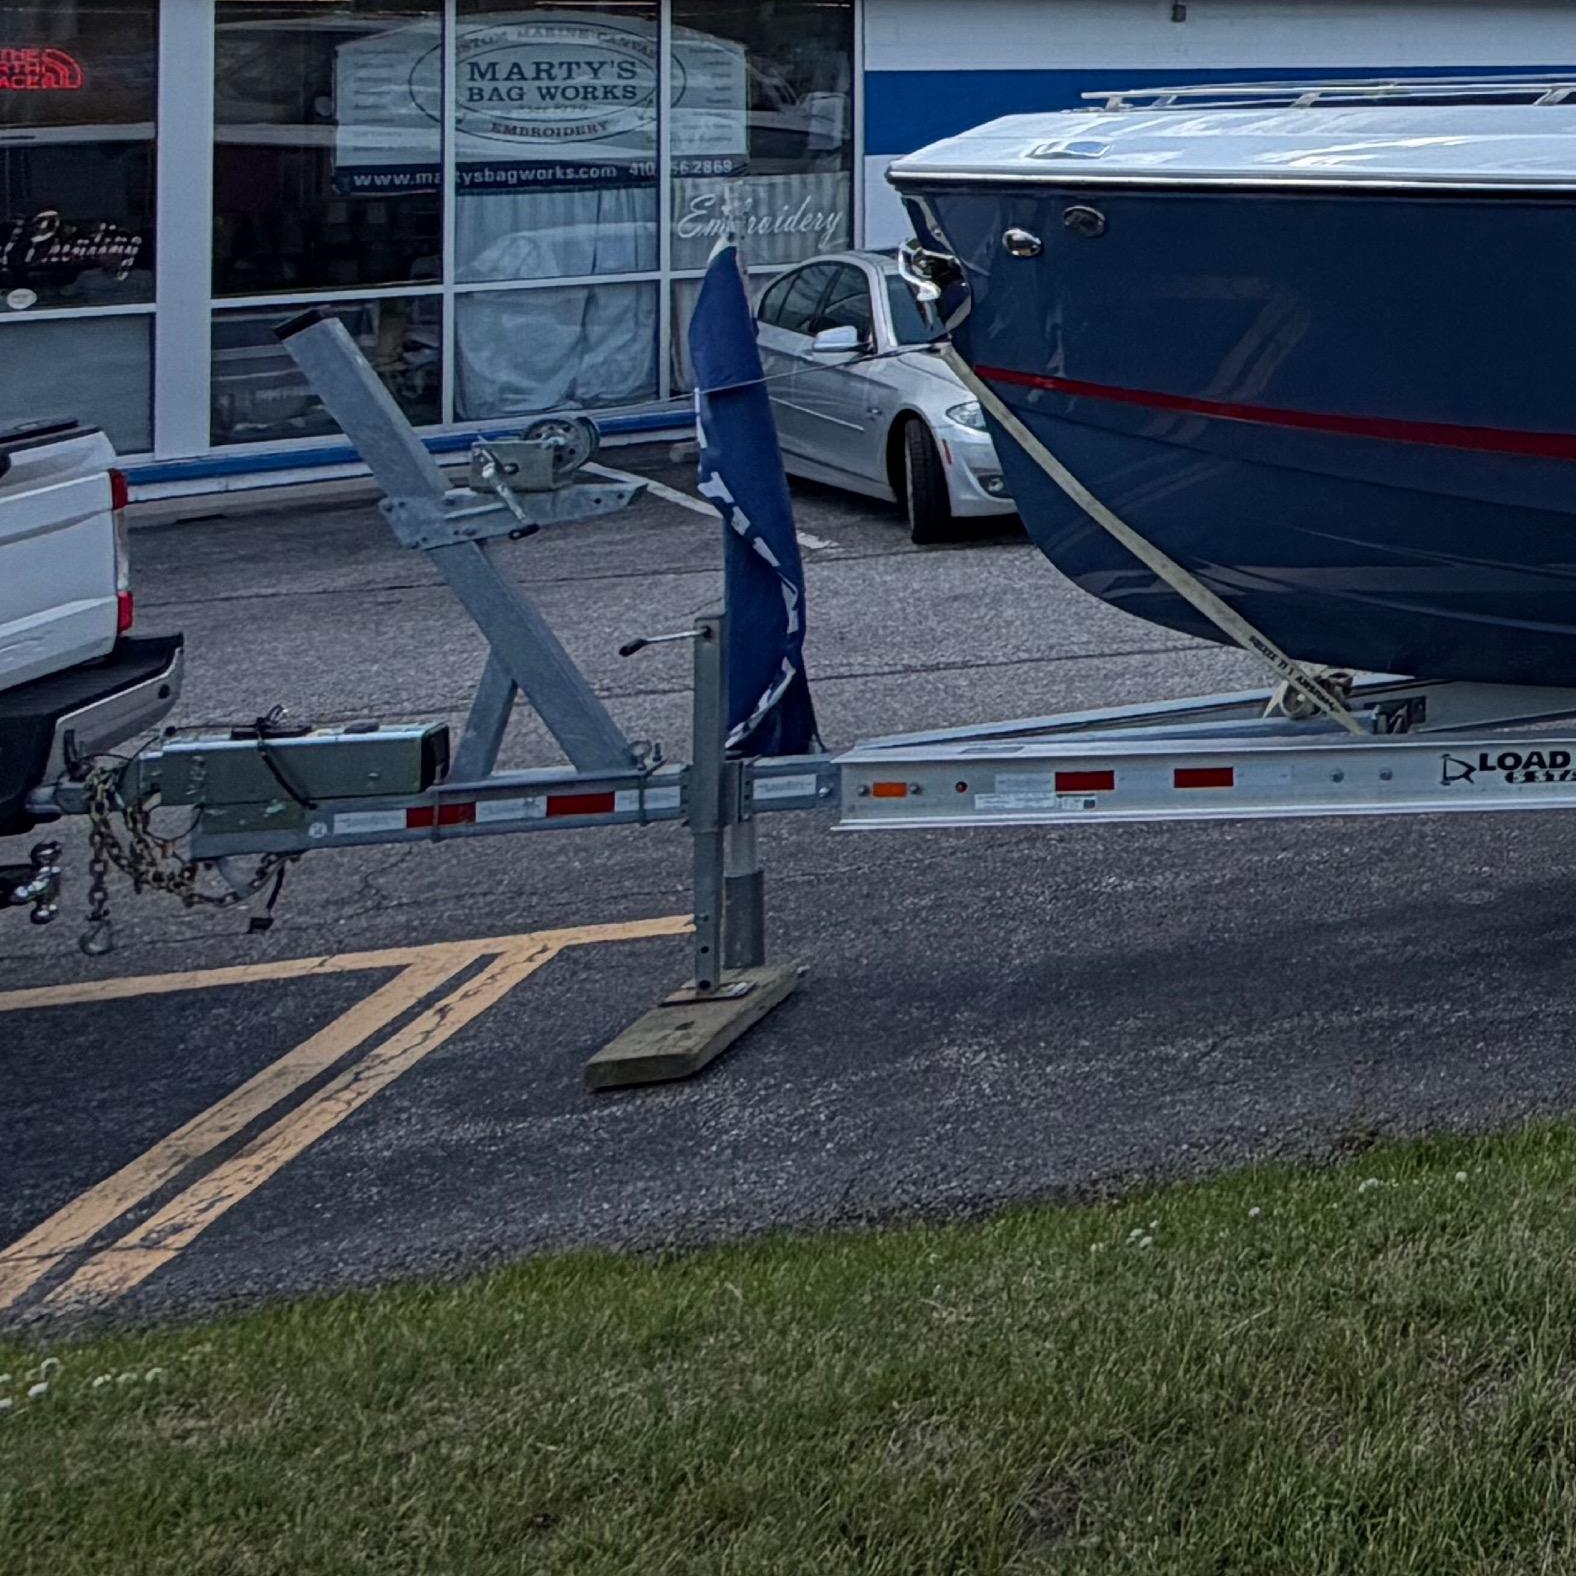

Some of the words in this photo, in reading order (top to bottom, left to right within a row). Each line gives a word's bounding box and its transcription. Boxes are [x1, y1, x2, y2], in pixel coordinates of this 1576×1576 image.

[467, 60, 639, 83] MARTY'S
[466, 86, 526, 103] BAG
[536, 84, 639, 102] WORKS
[490, 119, 610, 138] EMBROIDERY
[691, 158, 733, 175] 2869
[1478, 751, 1571, 772] LOAD
